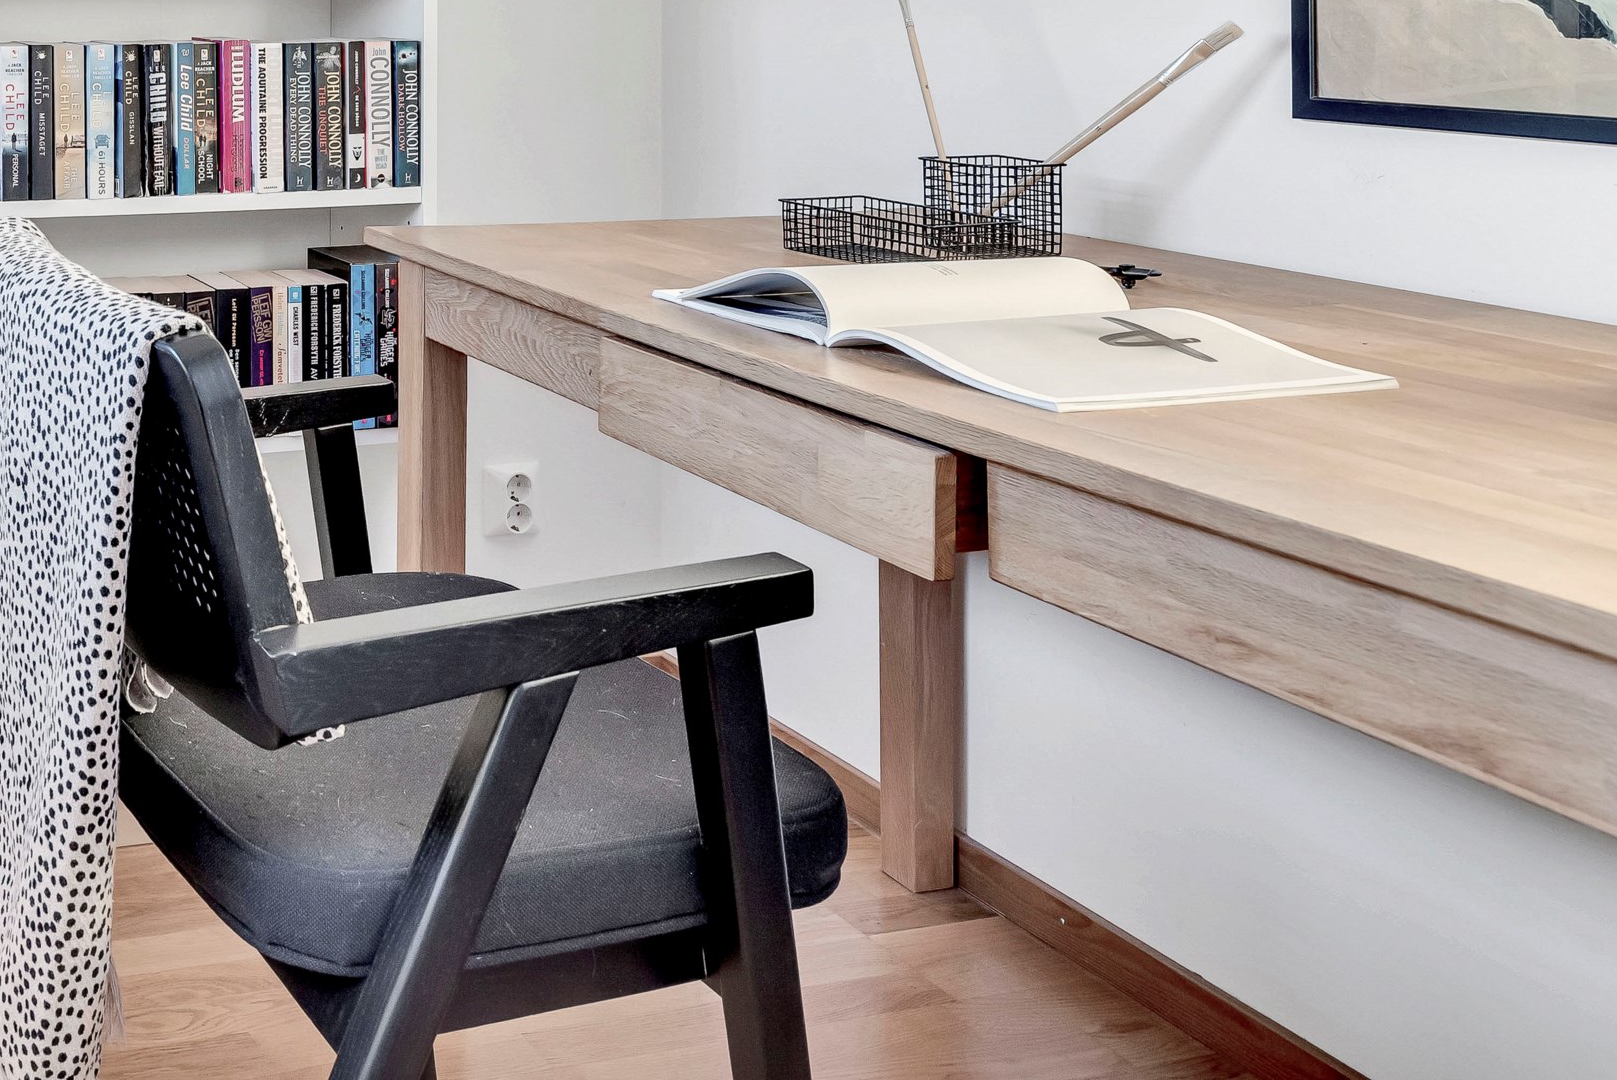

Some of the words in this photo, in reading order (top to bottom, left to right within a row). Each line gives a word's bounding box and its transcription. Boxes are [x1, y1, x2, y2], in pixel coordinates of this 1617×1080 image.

[259, 48, 267, 63] THE
[259, 65, 267, 113] AQUITAINE
[370, 56, 391, 148] CONNOLLY
[403, 69, 418, 102] JOHN
[259, 116, 268, 179] PROGRESSION
[405, 105, 419, 165] CONNOLLY
[310, 296, 318, 331] FREDERICK
[310, 332, 318, 365] FORSYTH
